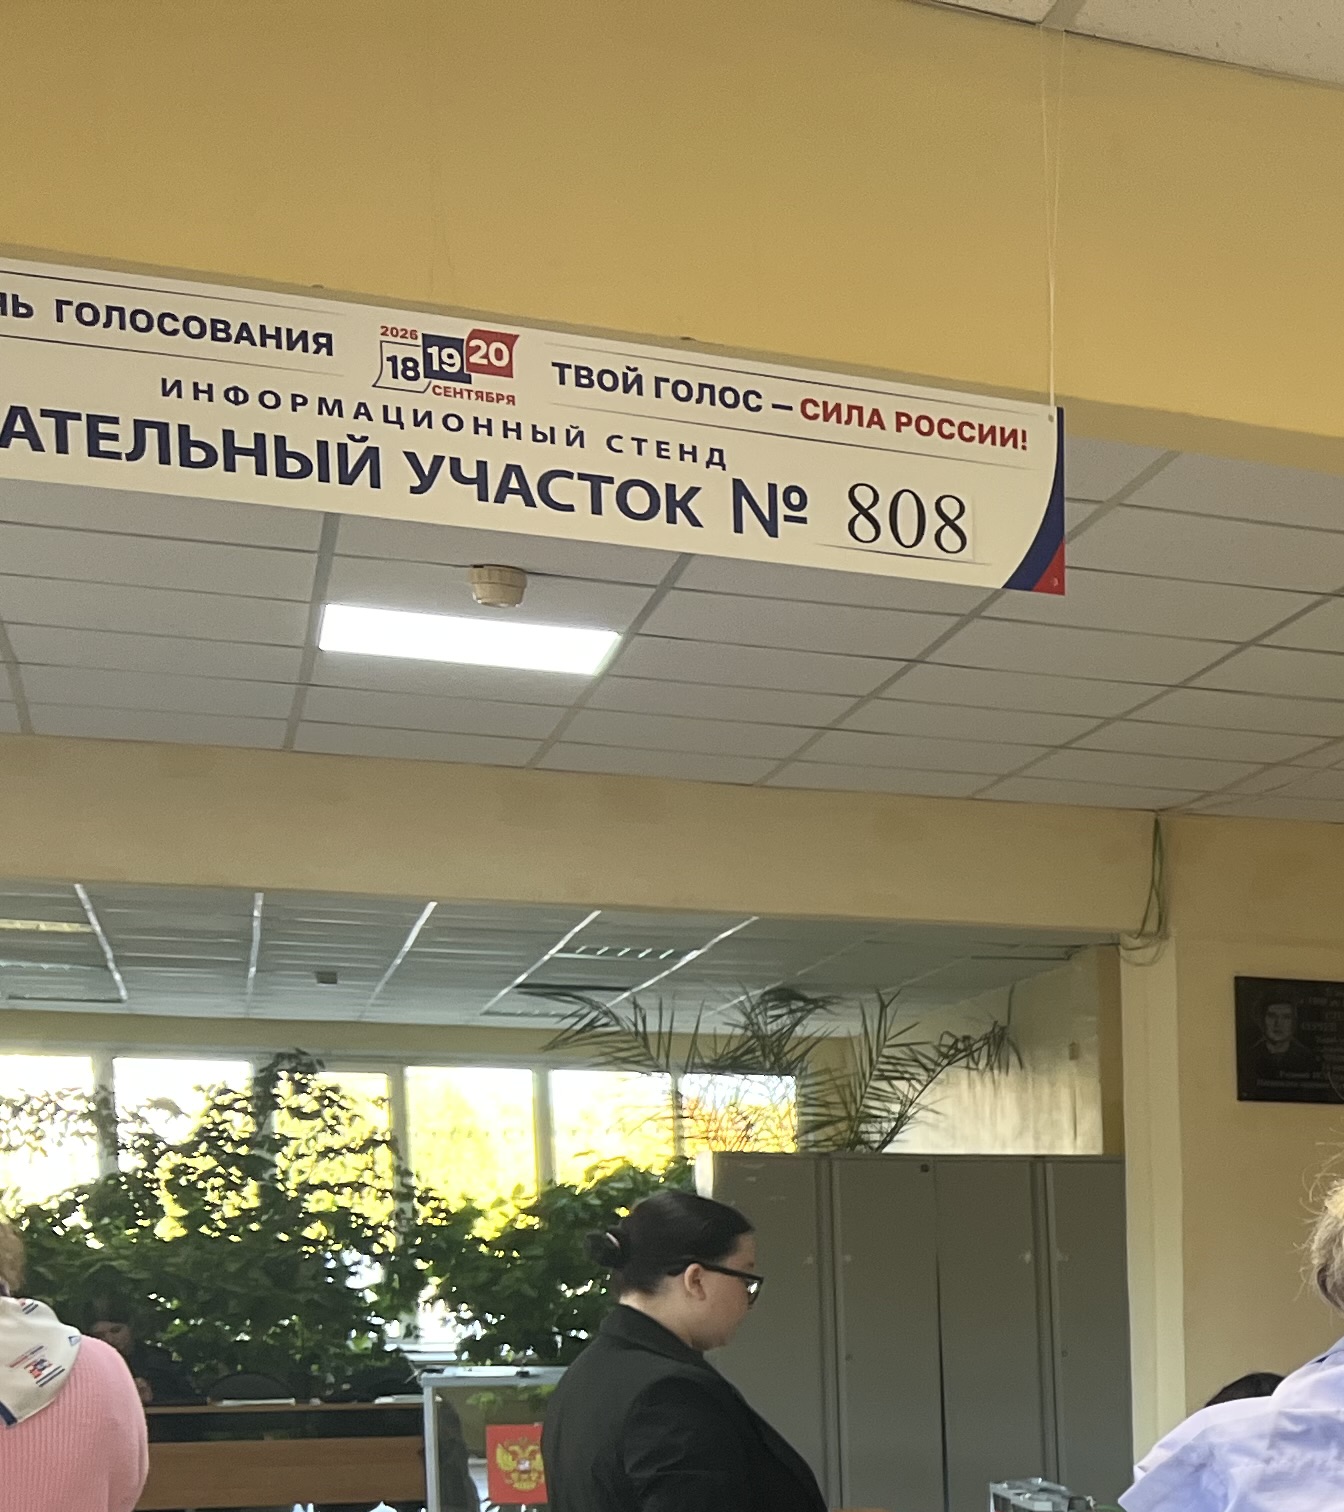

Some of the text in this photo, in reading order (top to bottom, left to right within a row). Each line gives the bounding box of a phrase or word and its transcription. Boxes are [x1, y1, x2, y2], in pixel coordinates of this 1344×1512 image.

[55, 299, 334, 356] ГОЛОСОВАНИЯ
[380, 326, 419, 340] 2026
[386, 337, 511, 381] 18 19 20
[161, 377, 727, 470] ИНФОРМАЦИОННЫЙ СТЕНД
[432, 384, 517, 406] СЕНТЯБРЯ
[551, 361, 644, 396] ТВОЙ
[654, 378, 763, 412] ГОЛОС
[800, 397, 886, 431] СИЛА
[895, 412, 1029, 451] РОССИИ!
[0, 405, 968, 554] АТЕЛЬНЫЙ УЧАСТОК № 808
